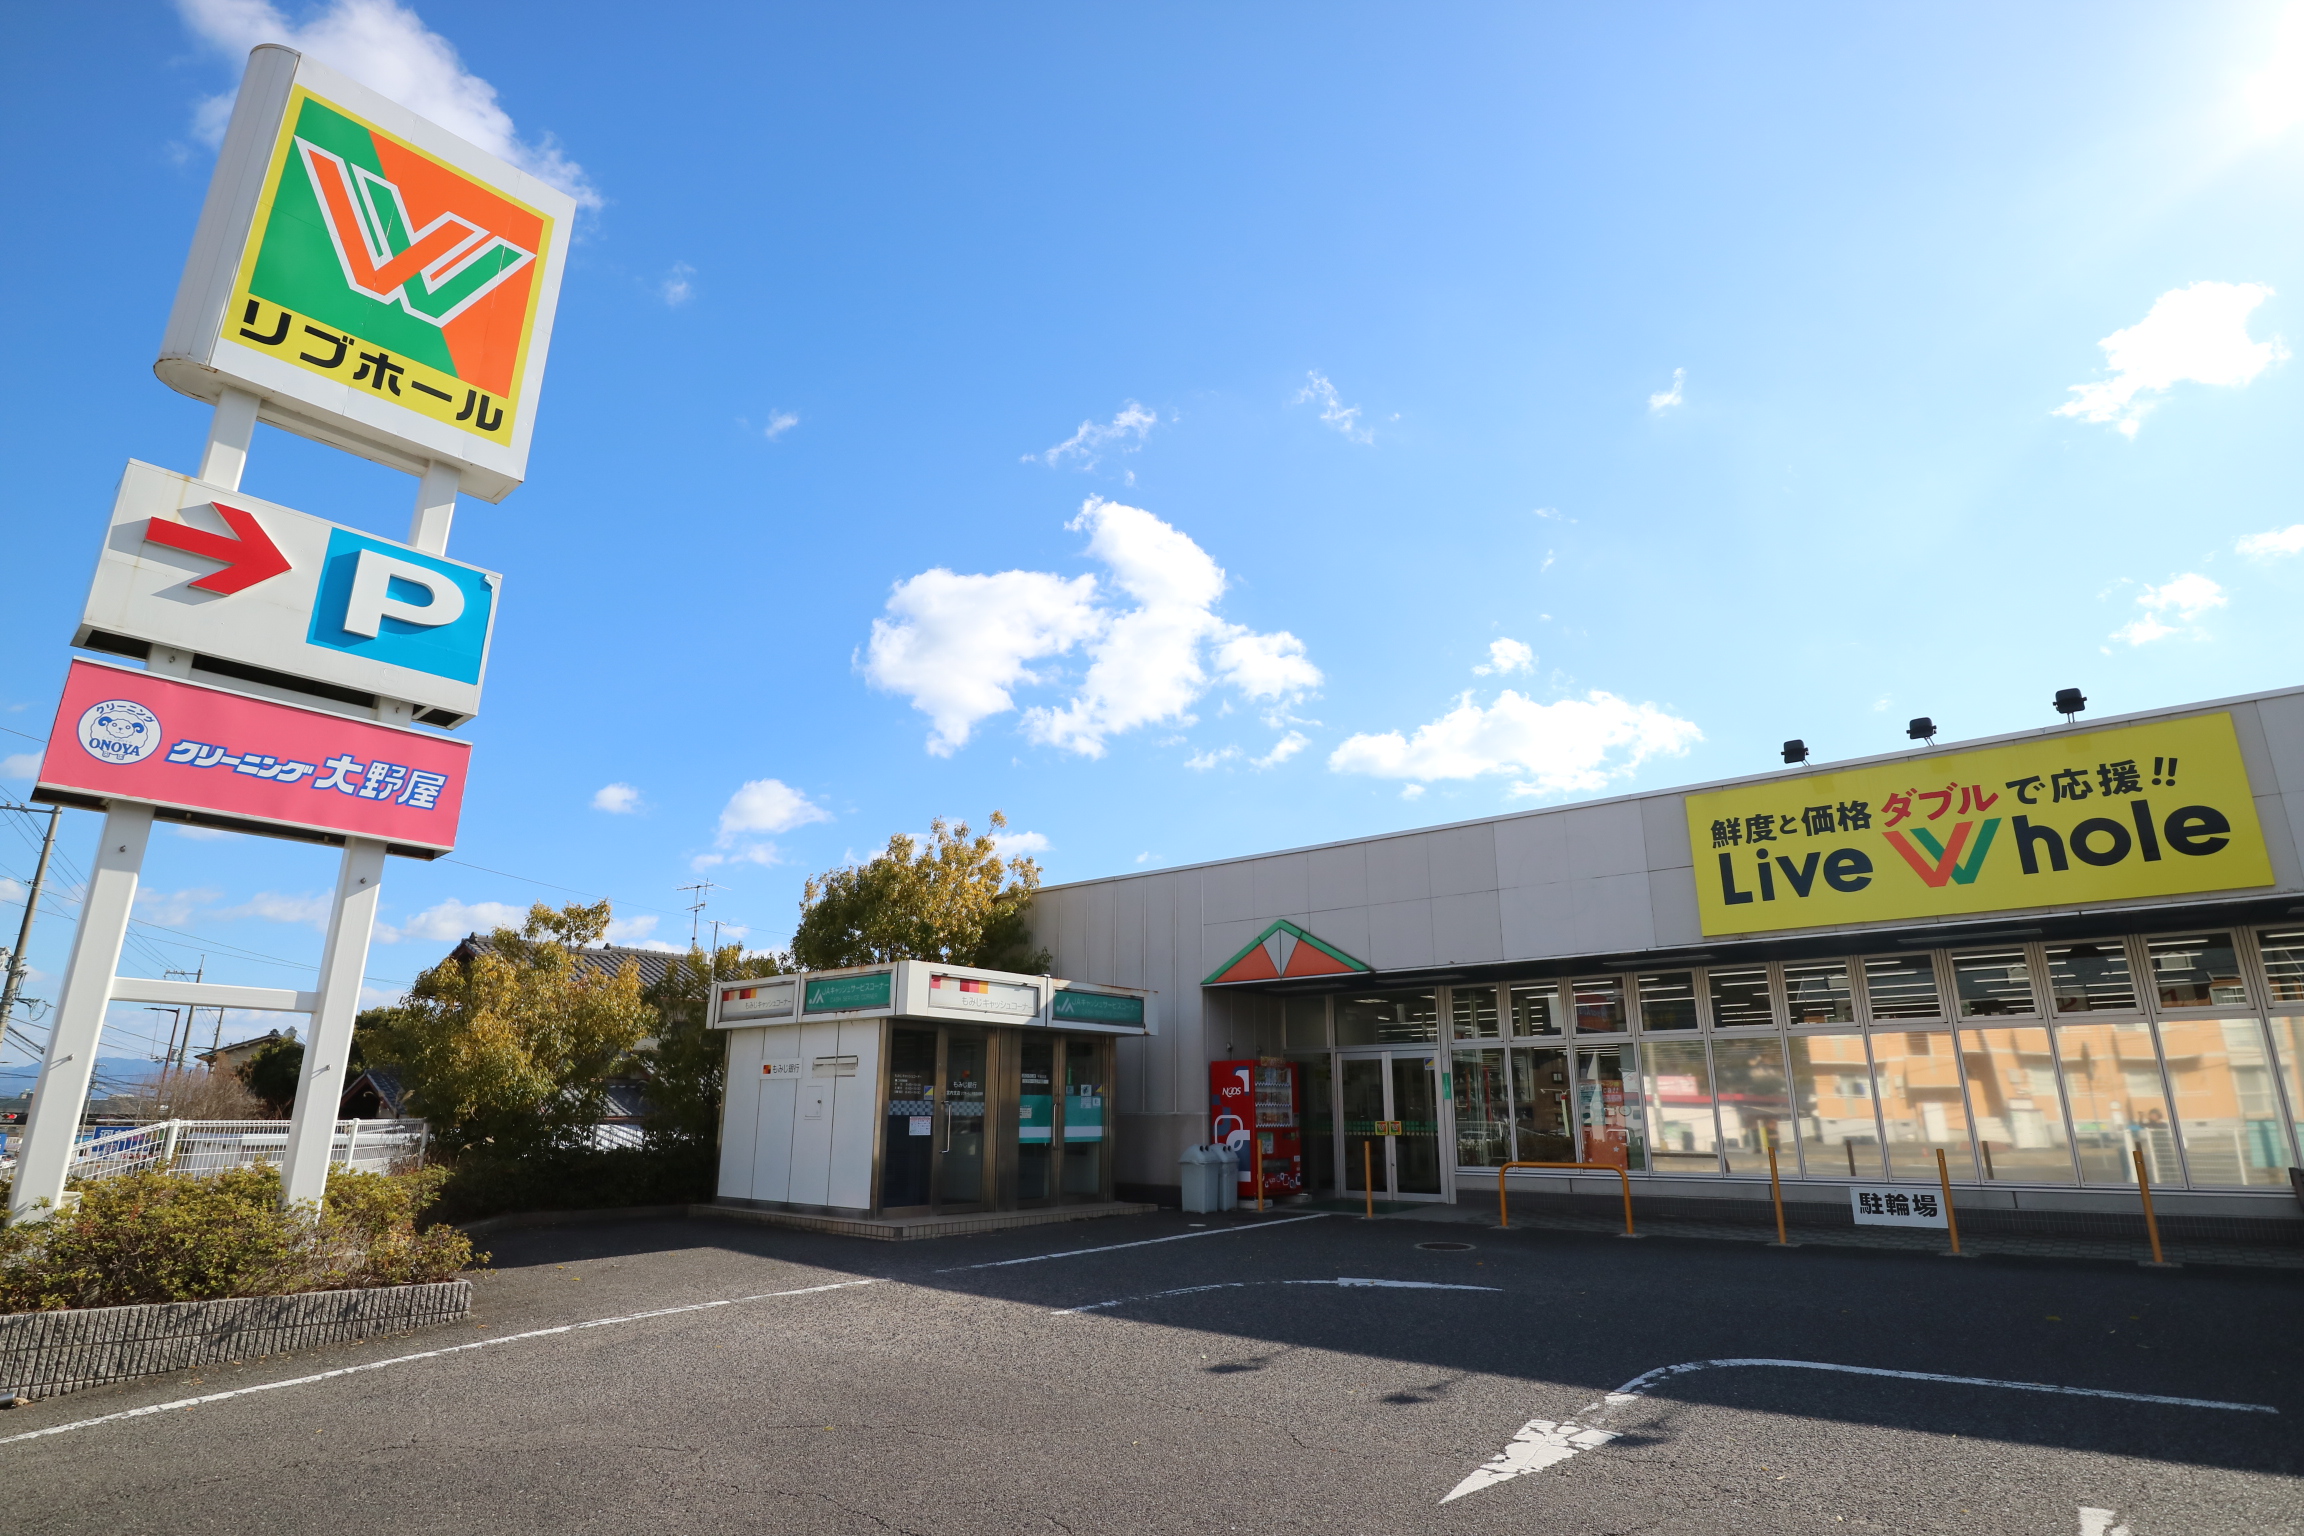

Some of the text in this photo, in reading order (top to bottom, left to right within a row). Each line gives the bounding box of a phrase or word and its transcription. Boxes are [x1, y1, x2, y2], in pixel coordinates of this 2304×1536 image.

[239, 298, 504, 433] リブホール
[342, 548, 466, 638] P
[89, 737, 140, 757] ONOYA
[1718, 847, 1874, 906] Live
[745, 1000, 792, 1010] もみじキャッシュコーナー
[961, 996, 1033, 1012] もみじキャッシュコーナー
[772, 1063, 800, 1074] もみじ銀行
[1858, 1192, 1938, 1218] 駐輪場
